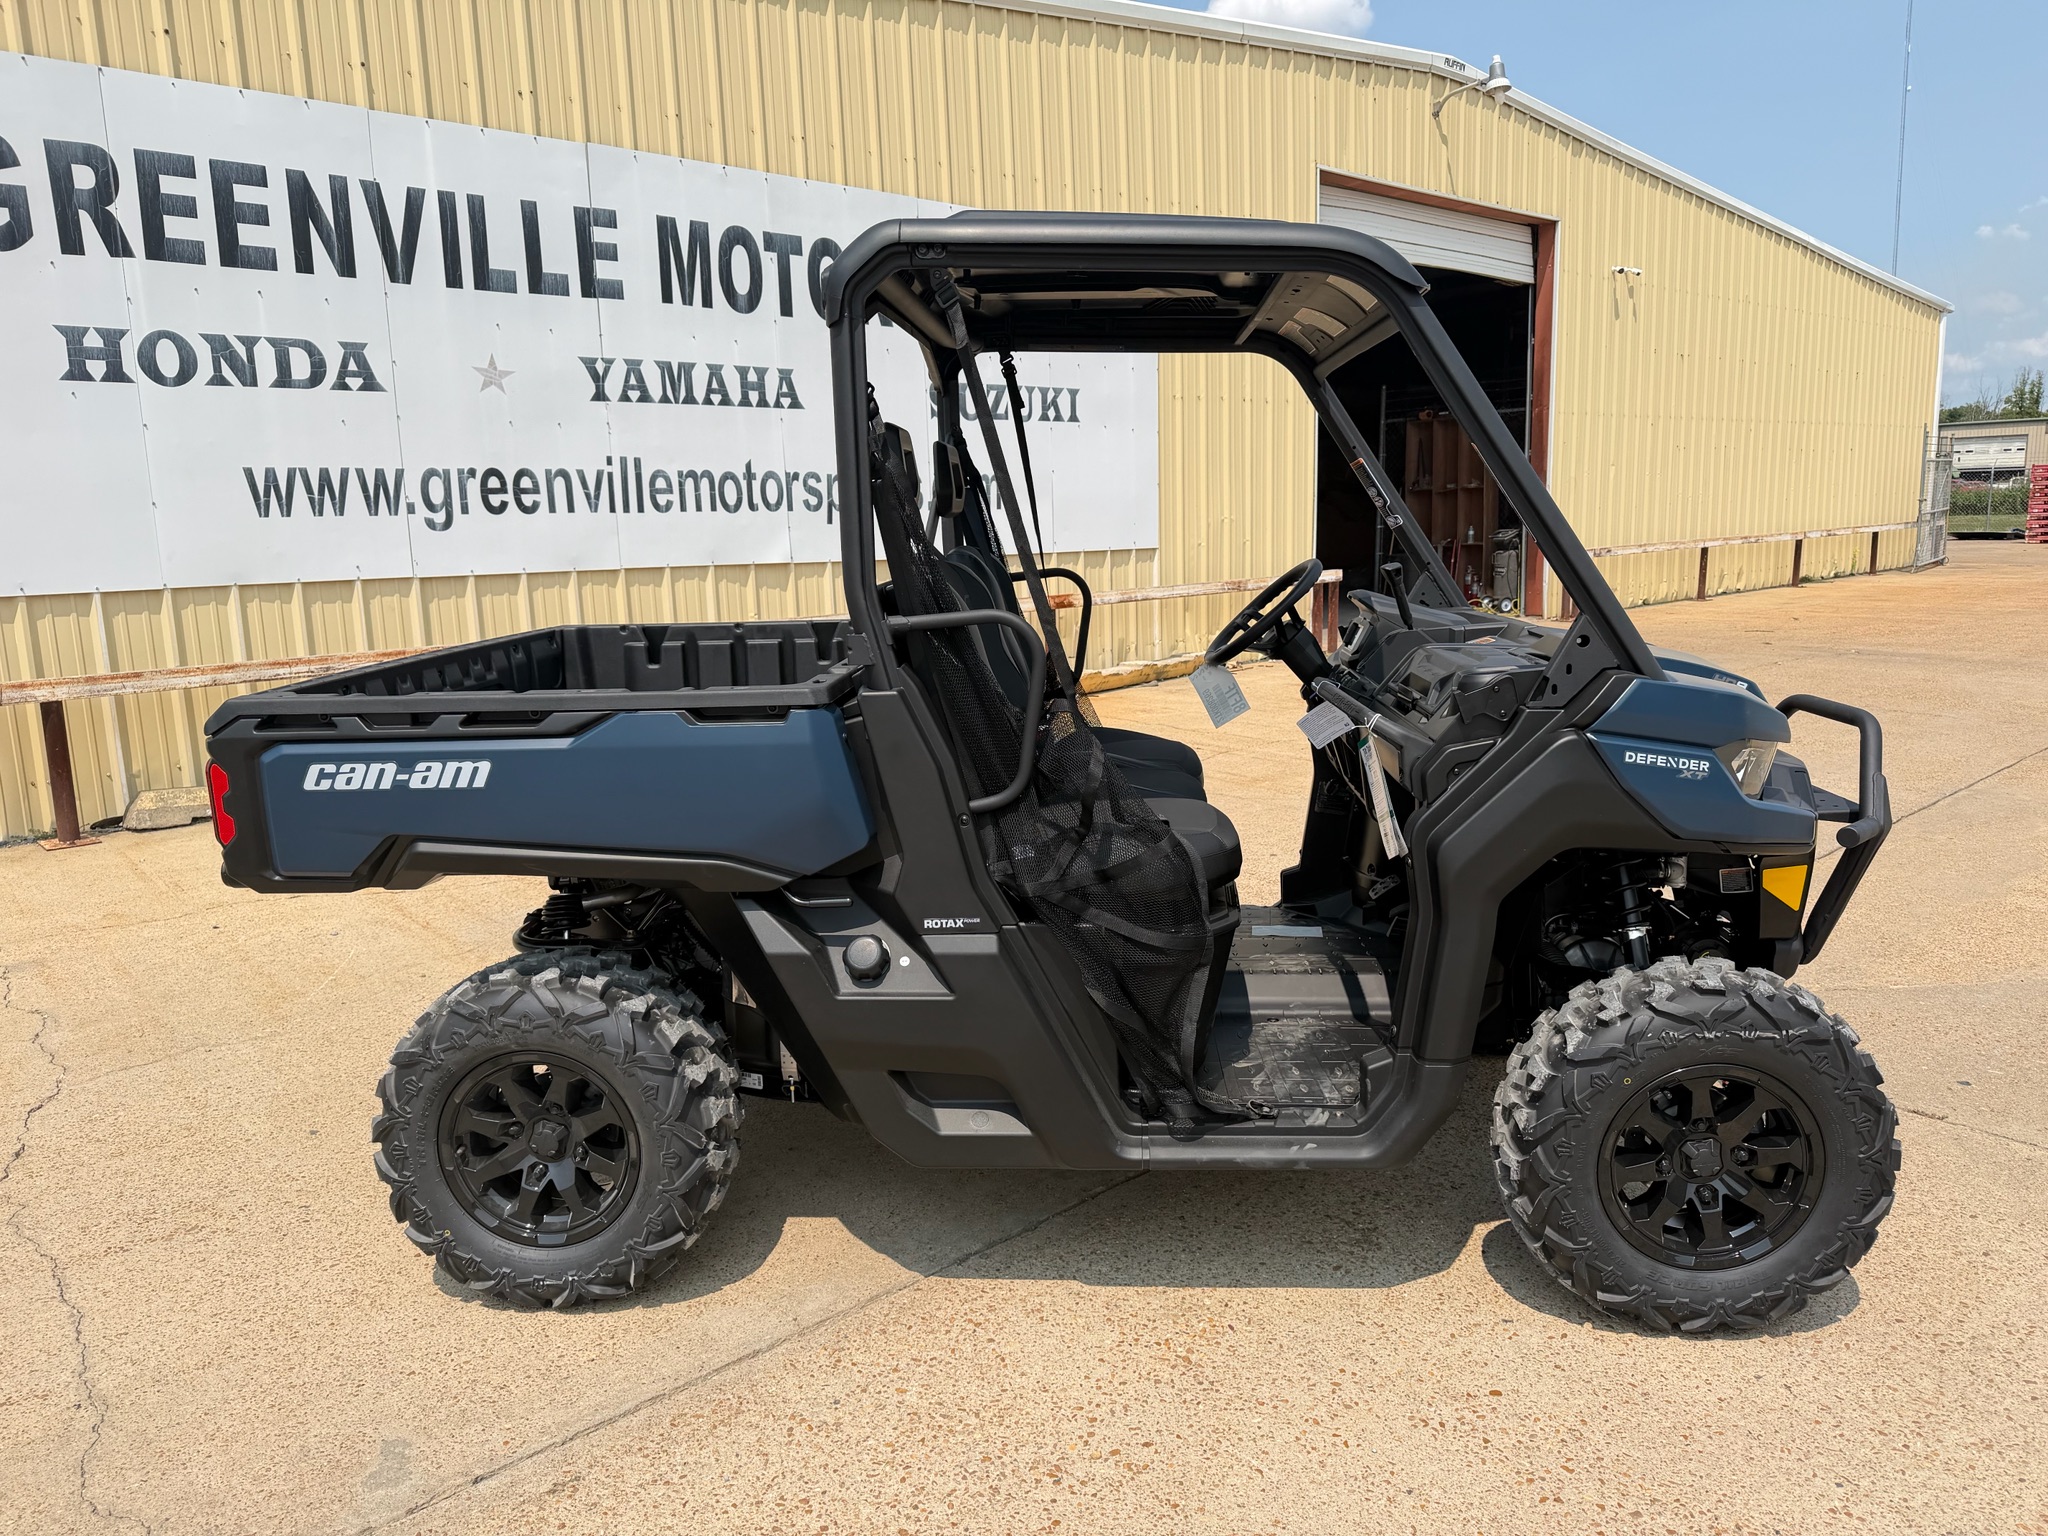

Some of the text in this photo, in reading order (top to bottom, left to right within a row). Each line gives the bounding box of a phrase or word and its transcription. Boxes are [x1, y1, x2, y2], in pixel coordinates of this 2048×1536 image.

[1444, 57, 1466, 71] RUFFIN
[52, 324, 388, 393] HONDA
[577, 355, 806, 410] YAMAHA
[1625, 751, 1710, 772] DEFENDER
[303, 760, 492, 791] can-am
[1679, 769, 1708, 780] XT
[924, 919, 964, 929] ROTAX
